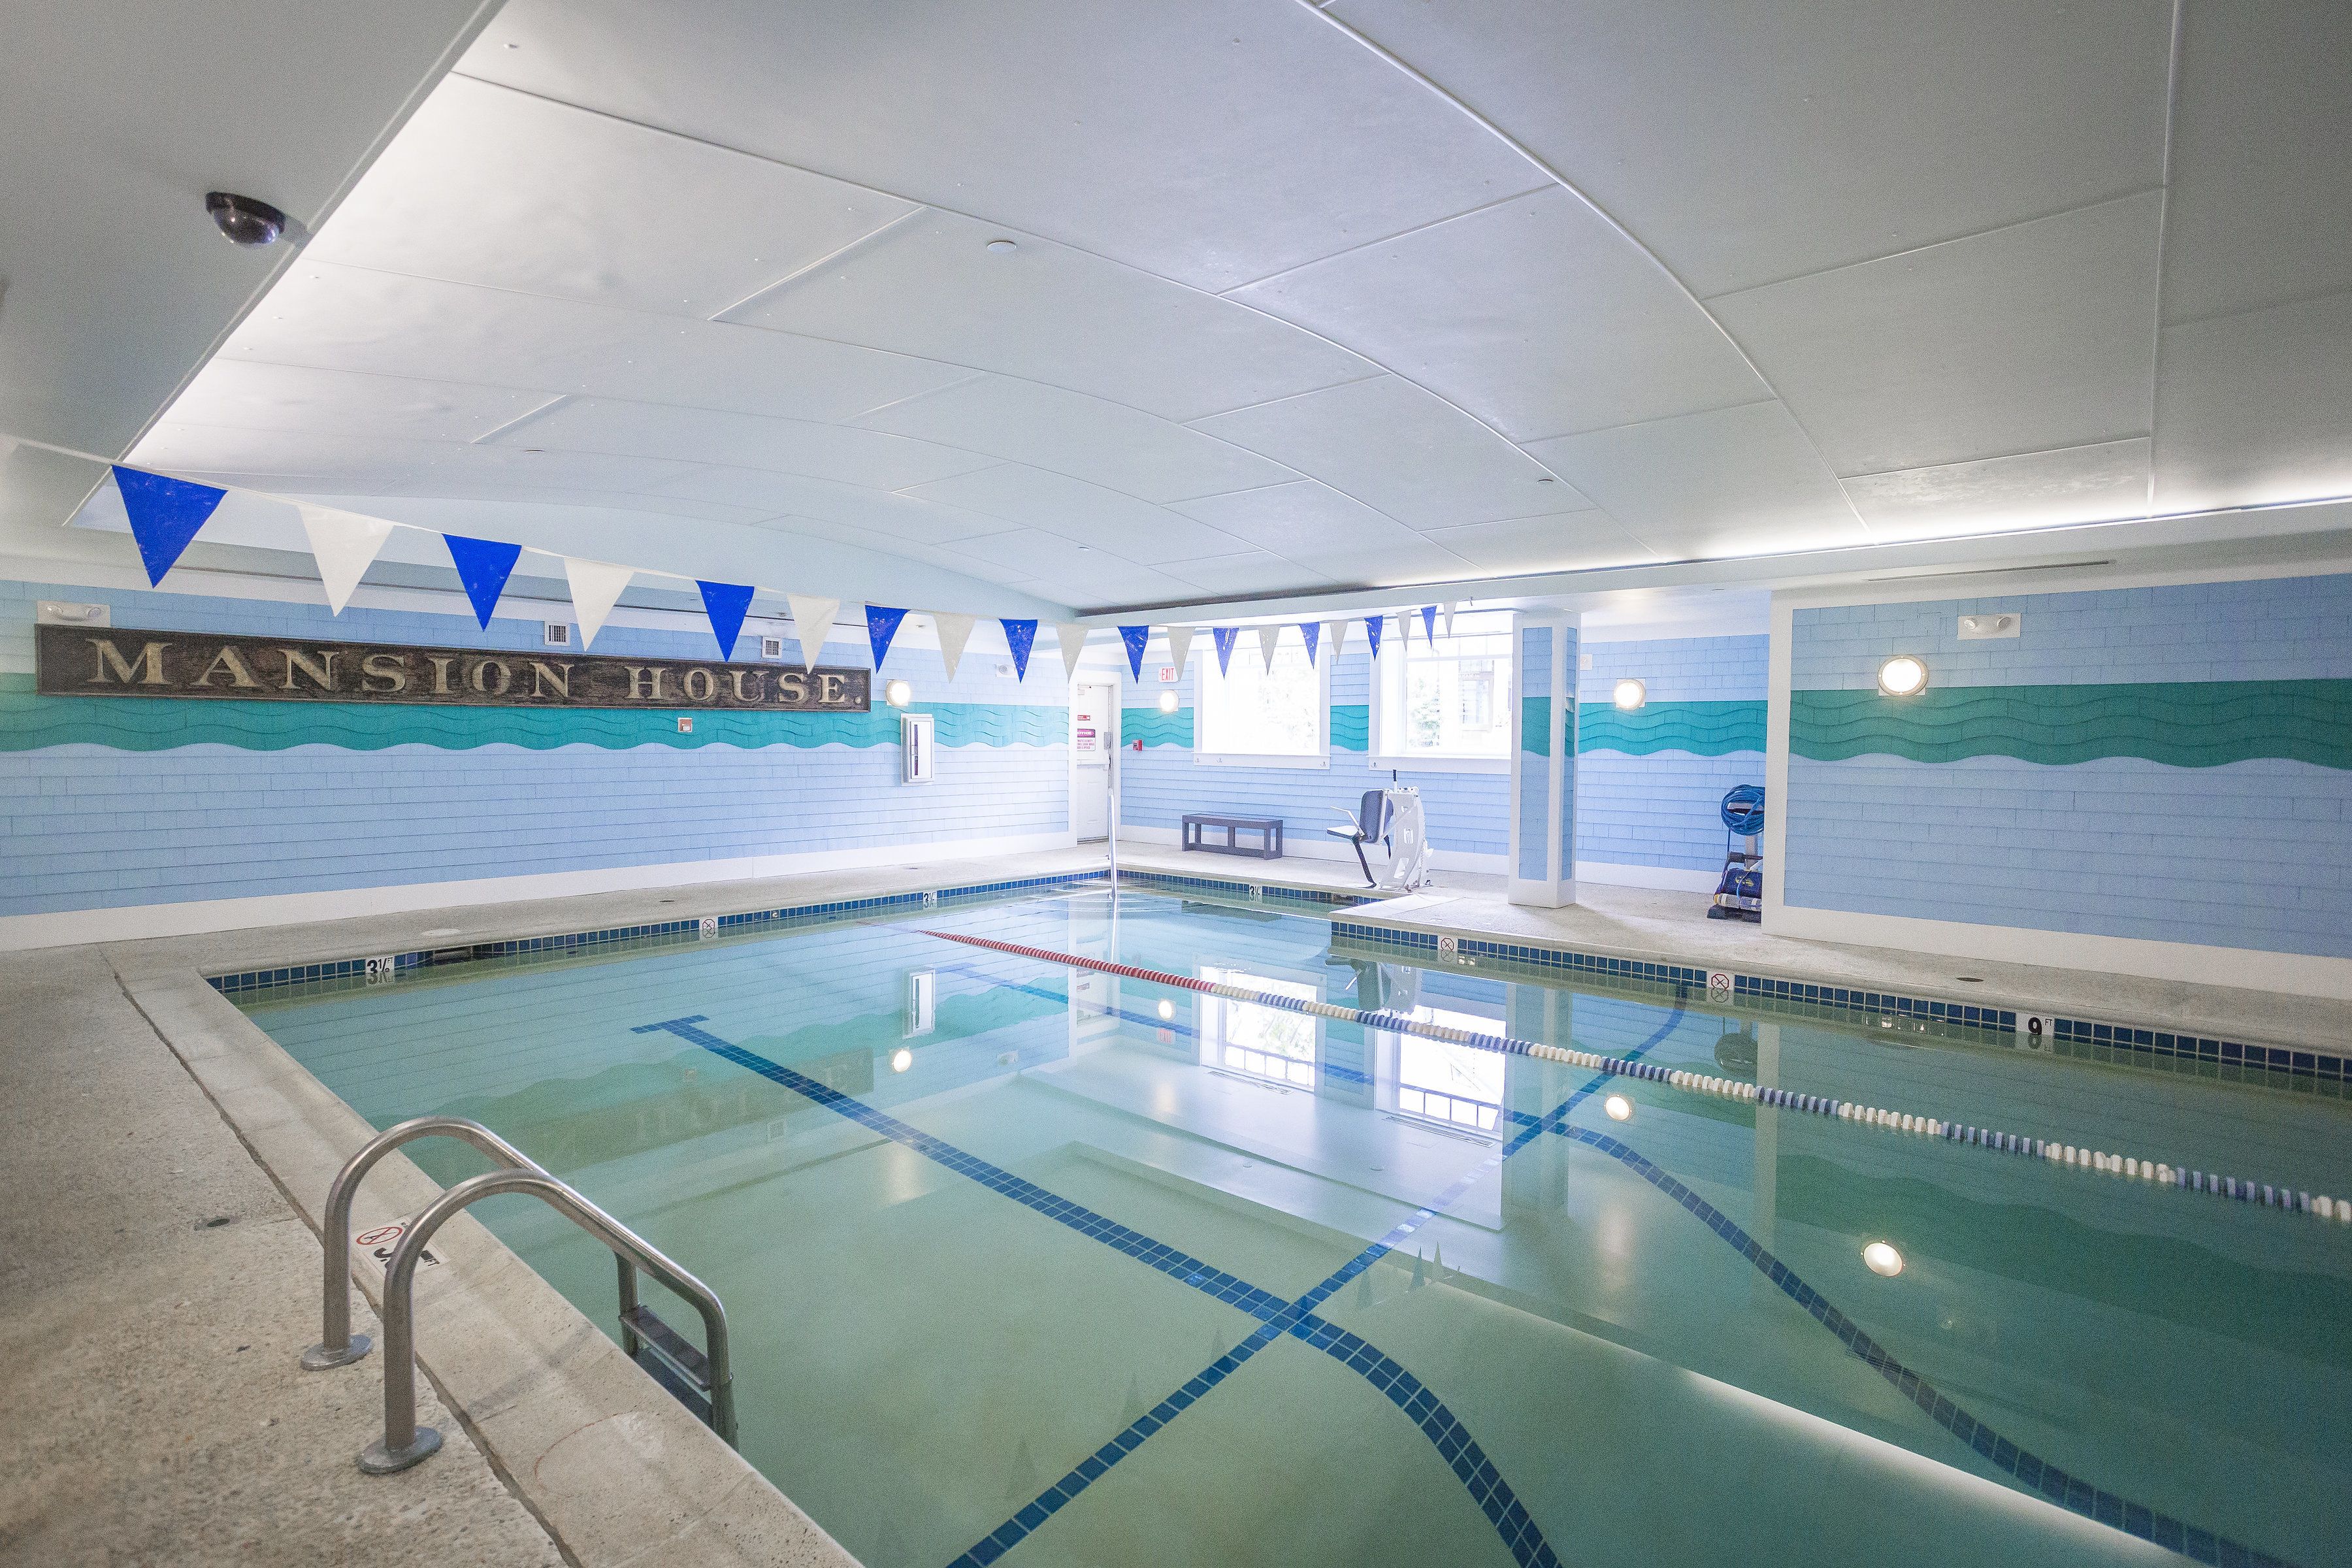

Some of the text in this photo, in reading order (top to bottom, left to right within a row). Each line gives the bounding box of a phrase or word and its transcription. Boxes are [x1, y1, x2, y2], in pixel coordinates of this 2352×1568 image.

[86, 637, 576, 698] MANSION
[1161, 668, 1175, 681] EXIT
[2027, 1017, 2053, 1036] 9 FT
